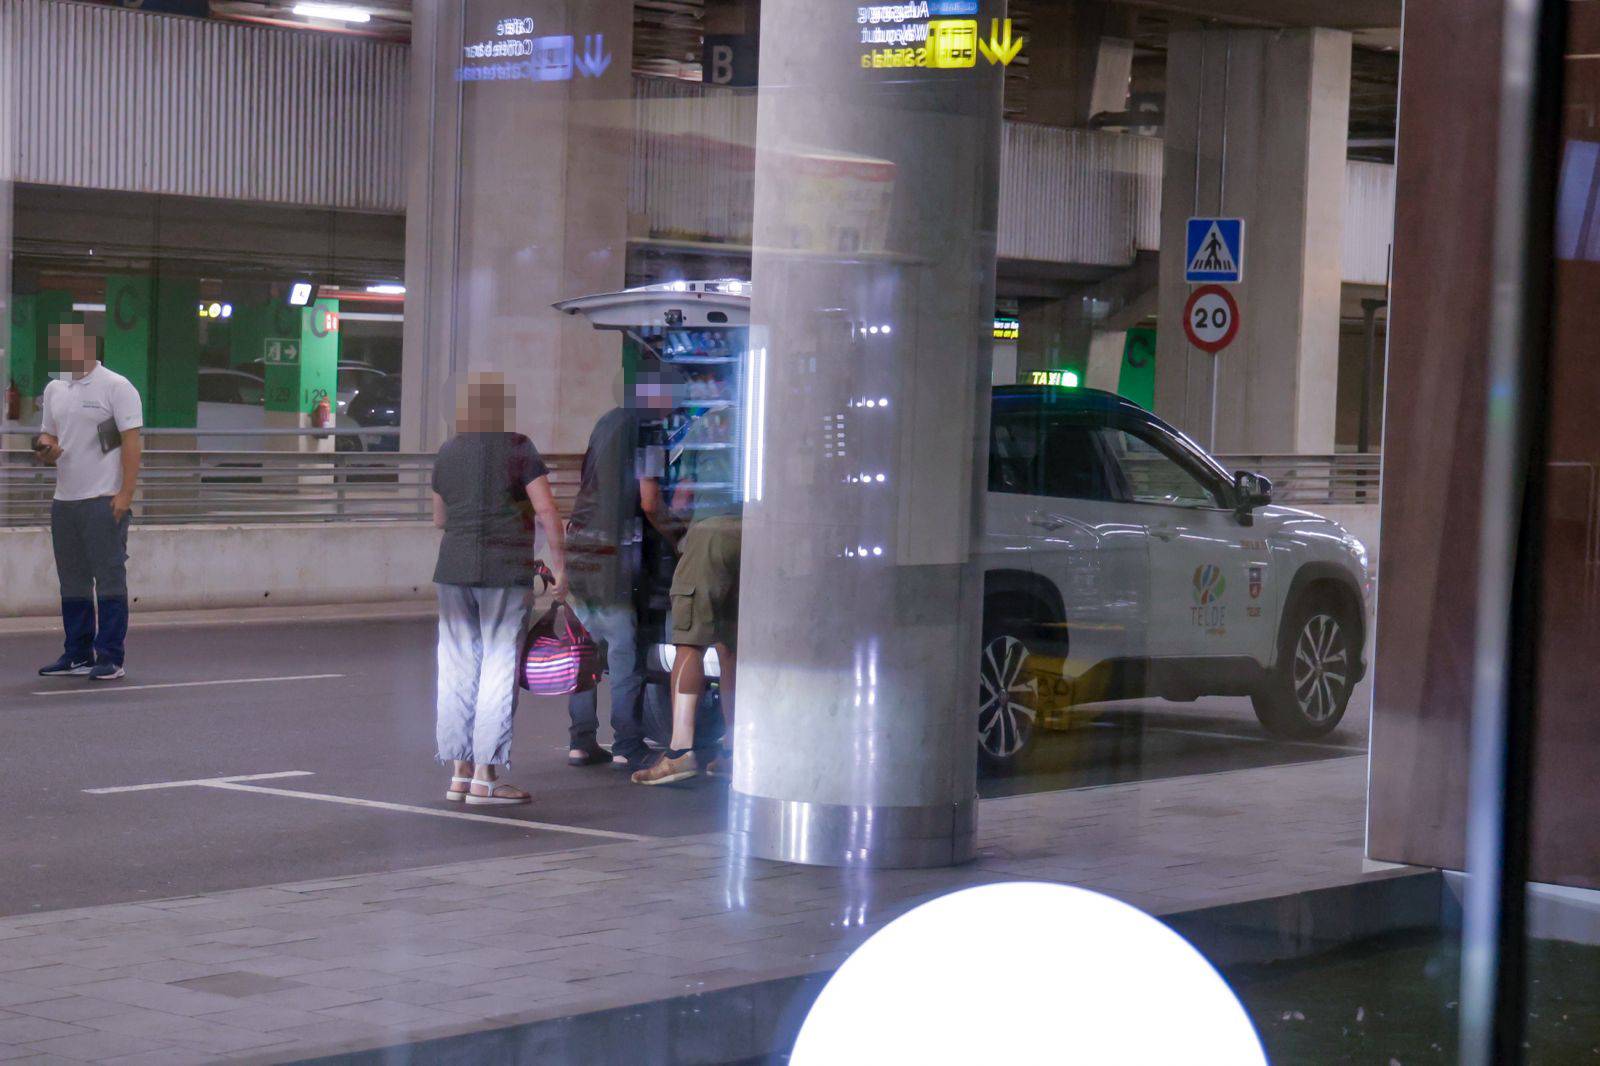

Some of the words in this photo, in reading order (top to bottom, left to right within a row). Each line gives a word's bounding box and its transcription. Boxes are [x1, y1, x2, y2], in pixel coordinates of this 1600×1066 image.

[713, 45, 733, 84] B
[1195, 308, 1227, 328] 20
[1032, 371, 1061, 385] TAXI
